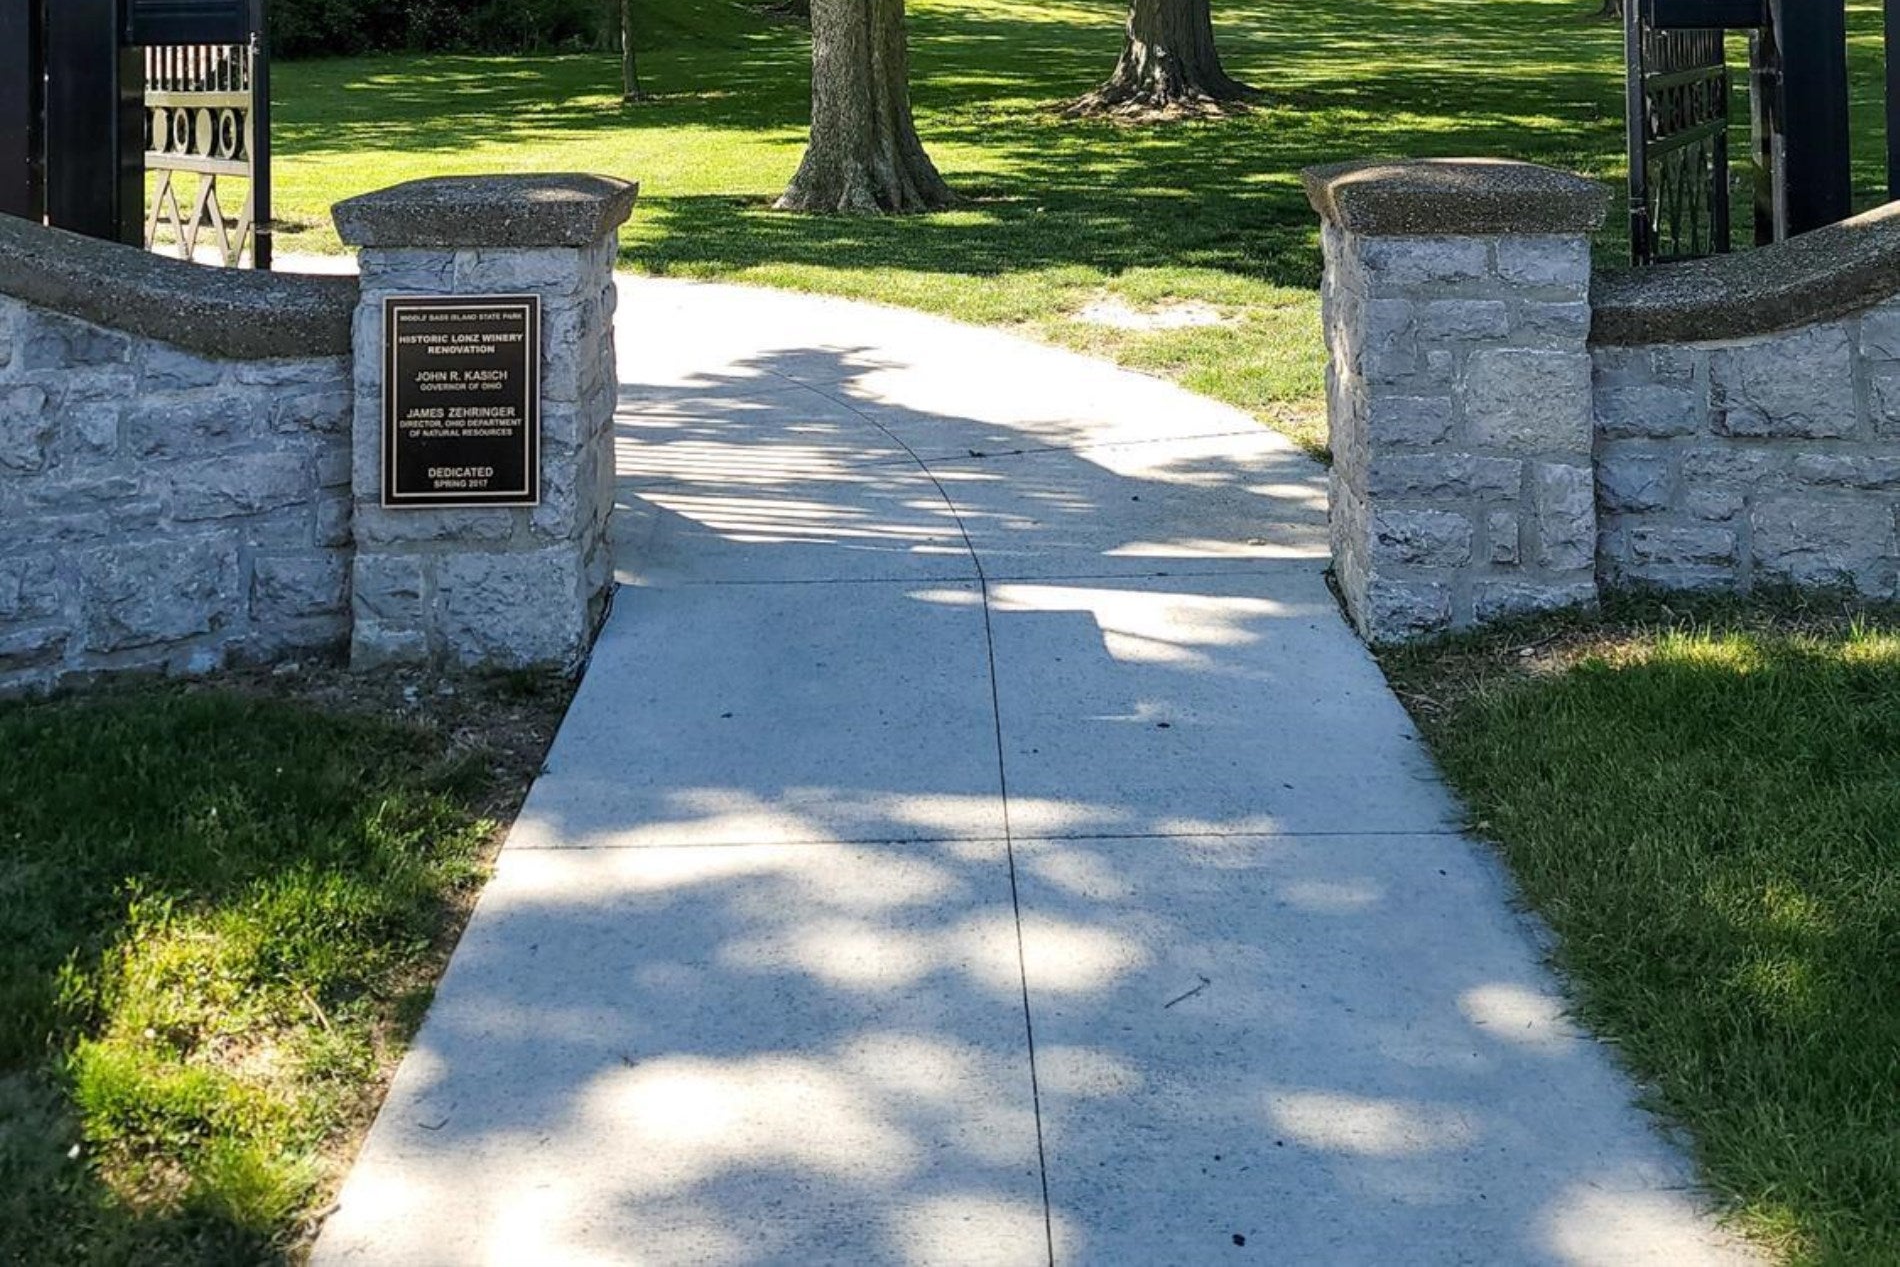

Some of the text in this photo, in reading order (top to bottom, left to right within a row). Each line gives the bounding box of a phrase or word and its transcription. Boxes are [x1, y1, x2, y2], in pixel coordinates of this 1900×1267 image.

[479, 313, 500, 321] STATE
[503, 312, 523, 320] PARK
[399, 333, 523, 344] HISTORIC LONZ WINERY
[428, 345, 495, 354] RENOVATION
[415, 370, 508, 382] JOHN R. KASICH
[420, 382, 502, 391] GOVERNOR OF OHIO
[406, 406, 515, 418] JAMES ZEHRINGER
[445, 419, 466, 427] OHIO
[467, 418, 522, 427] DEPARTMENT
[409, 428, 513, 437] OF NATURAL RESOURCES
[428, 466, 494, 478] DEDICATED
[433, 479, 489, 488] SPRING 2017
